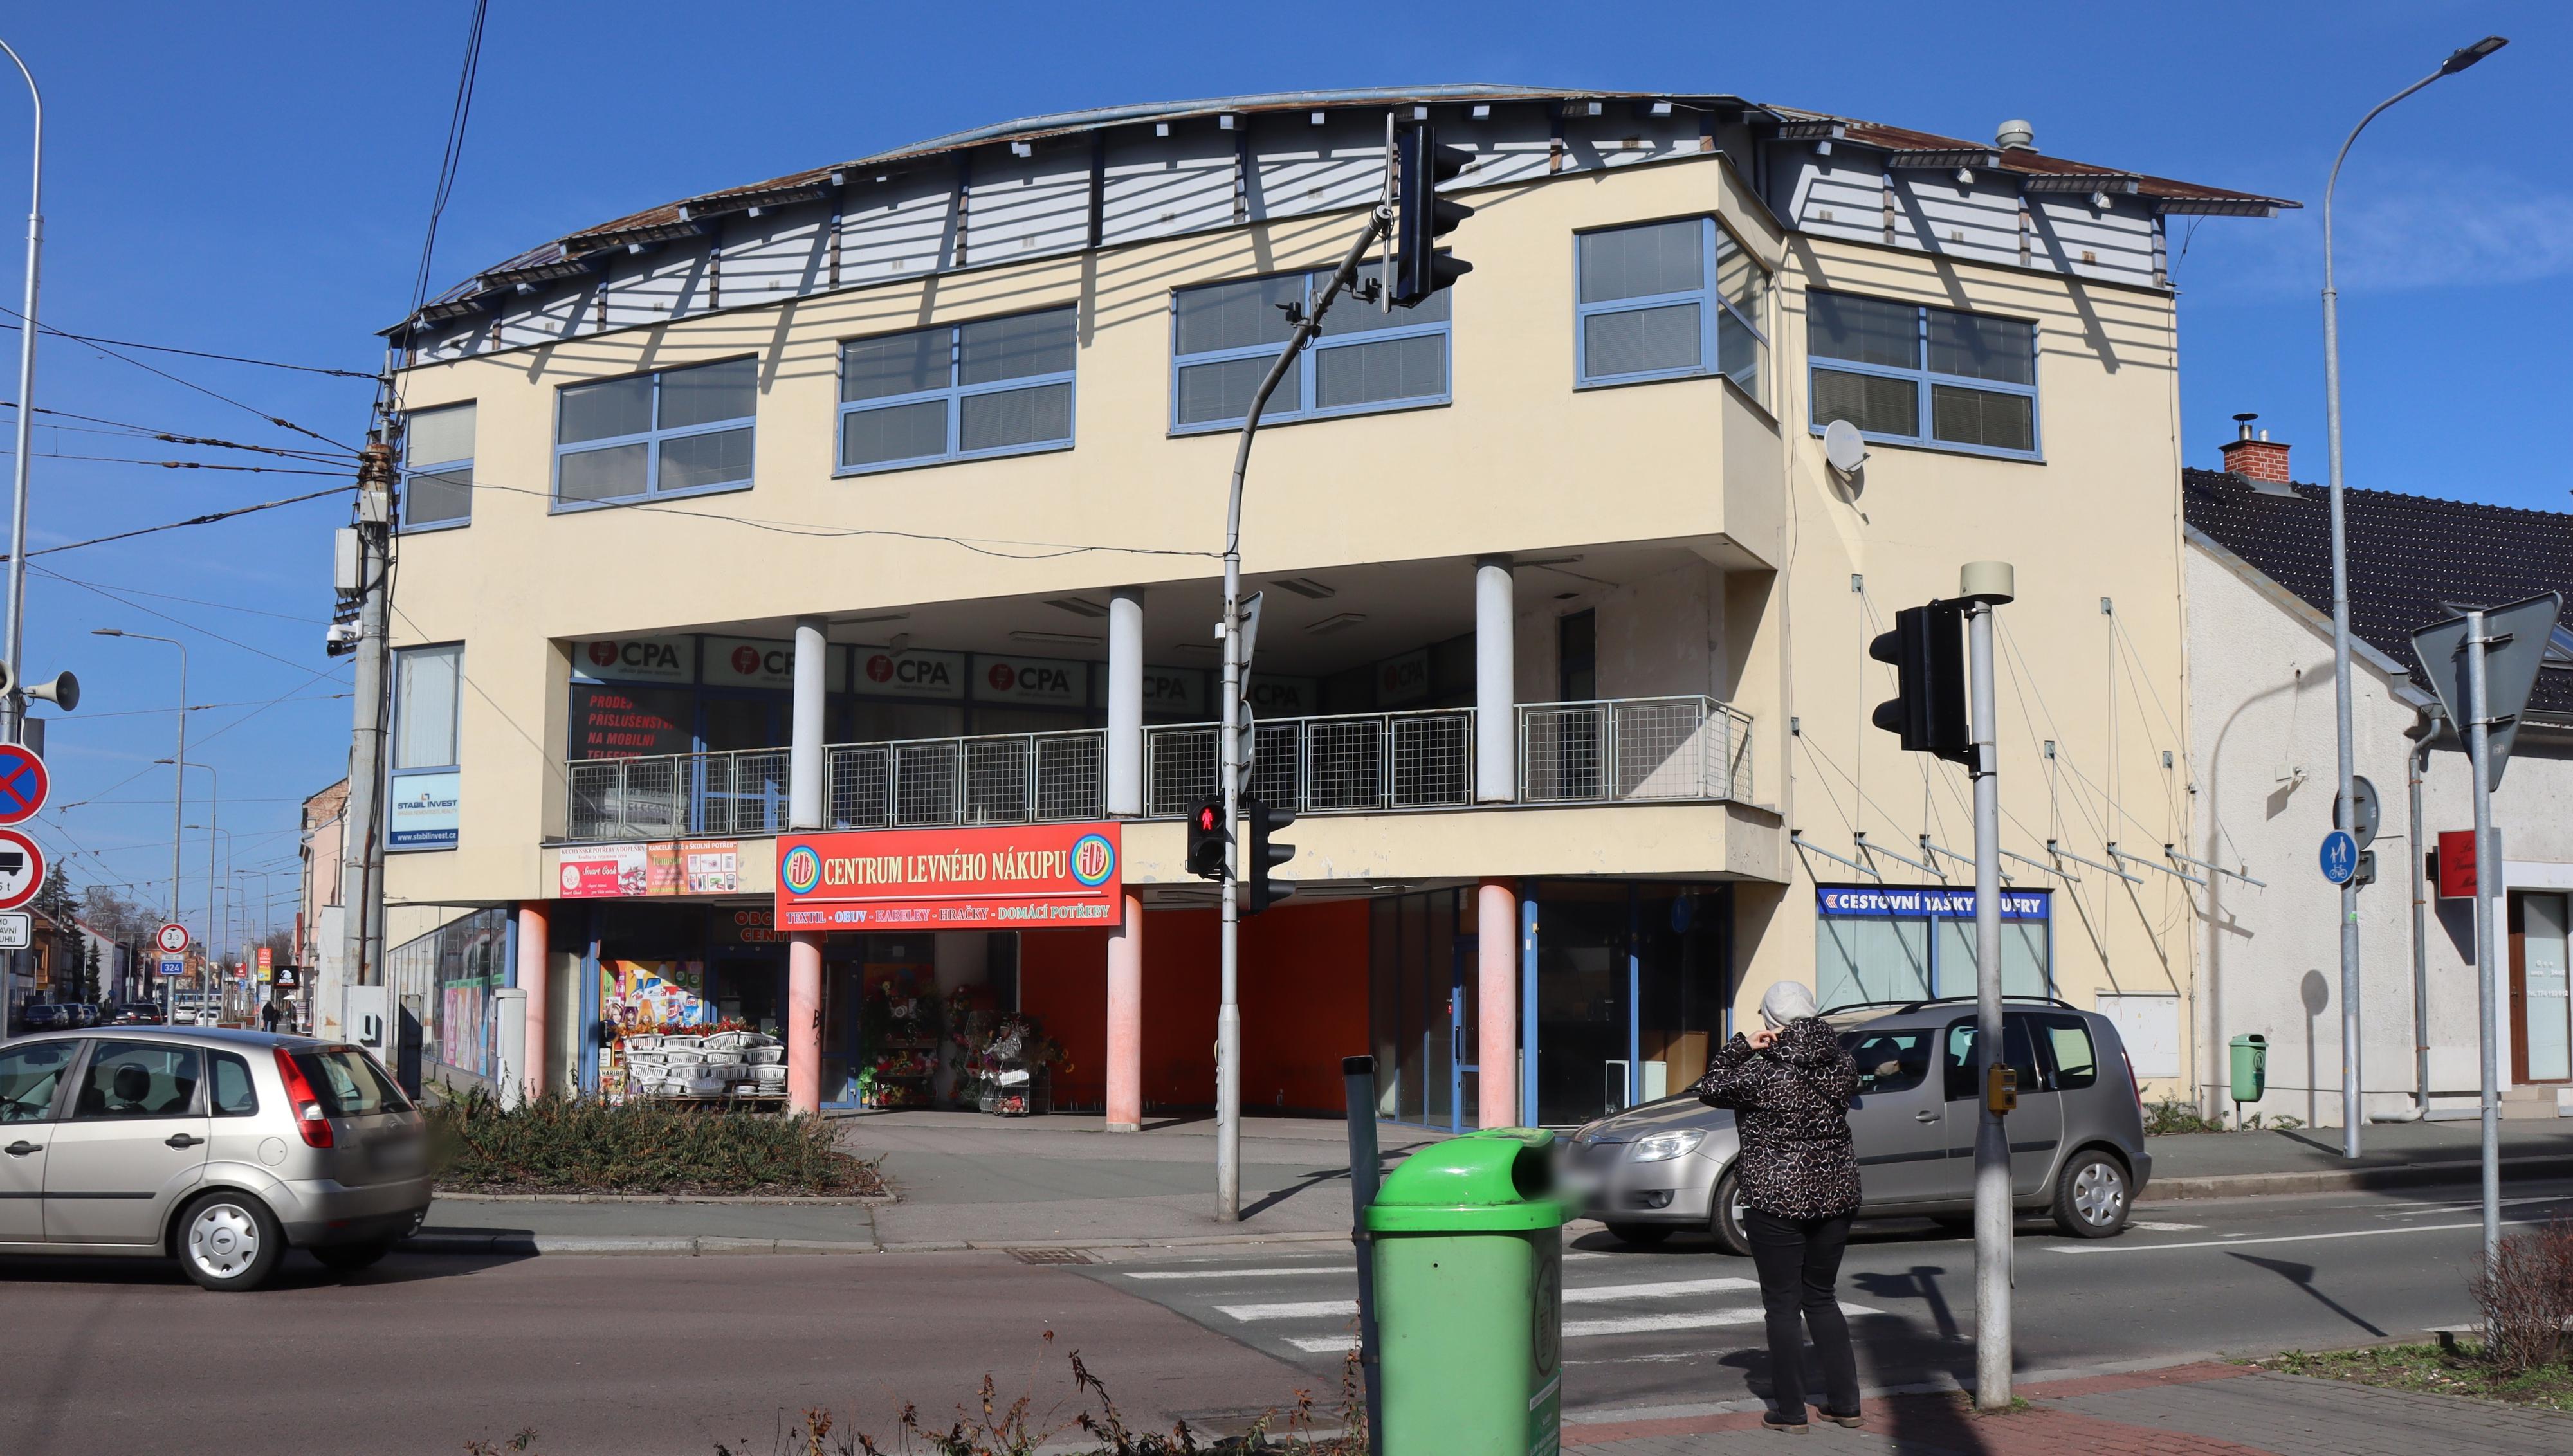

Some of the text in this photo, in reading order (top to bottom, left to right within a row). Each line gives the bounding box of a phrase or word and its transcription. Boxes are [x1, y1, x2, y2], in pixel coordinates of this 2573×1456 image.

[621, 642, 679, 669] CPA
[763, 651, 794, 675] CP
[897, 660, 950, 685] CPA
[1018, 668, 1070, 692] CPA
[587, 731, 656, 747] NA MOBILNÍ
[397, 831, 456, 841] www.stabilinvest.cz
[648, 842, 684, 851] KANCELÁŘSKÉ
[690, 841, 710, 850] ŠKOLNÍ
[582, 865, 617, 875] Smart Cook
[652, 855, 682, 866] Teamstar
[824, 846, 1067, 886] CENTRUM LEVNÉHO NÁKUPU
[786, 911, 826, 924] TEXTIL
[834, 911, 867, 923] OBUV
[875, 909, 930, 922] KABELKY
[939, 905, 989, 921] HRAČKY
[998, 903, 1048, 920] DOMÁCÍ
[1050, 902, 1110, 919] POTŘEBY
[1840, 893, 2041, 913] CESTOVNÍ TAŠKY UFRY
[164, 963, 179, 972] 324
